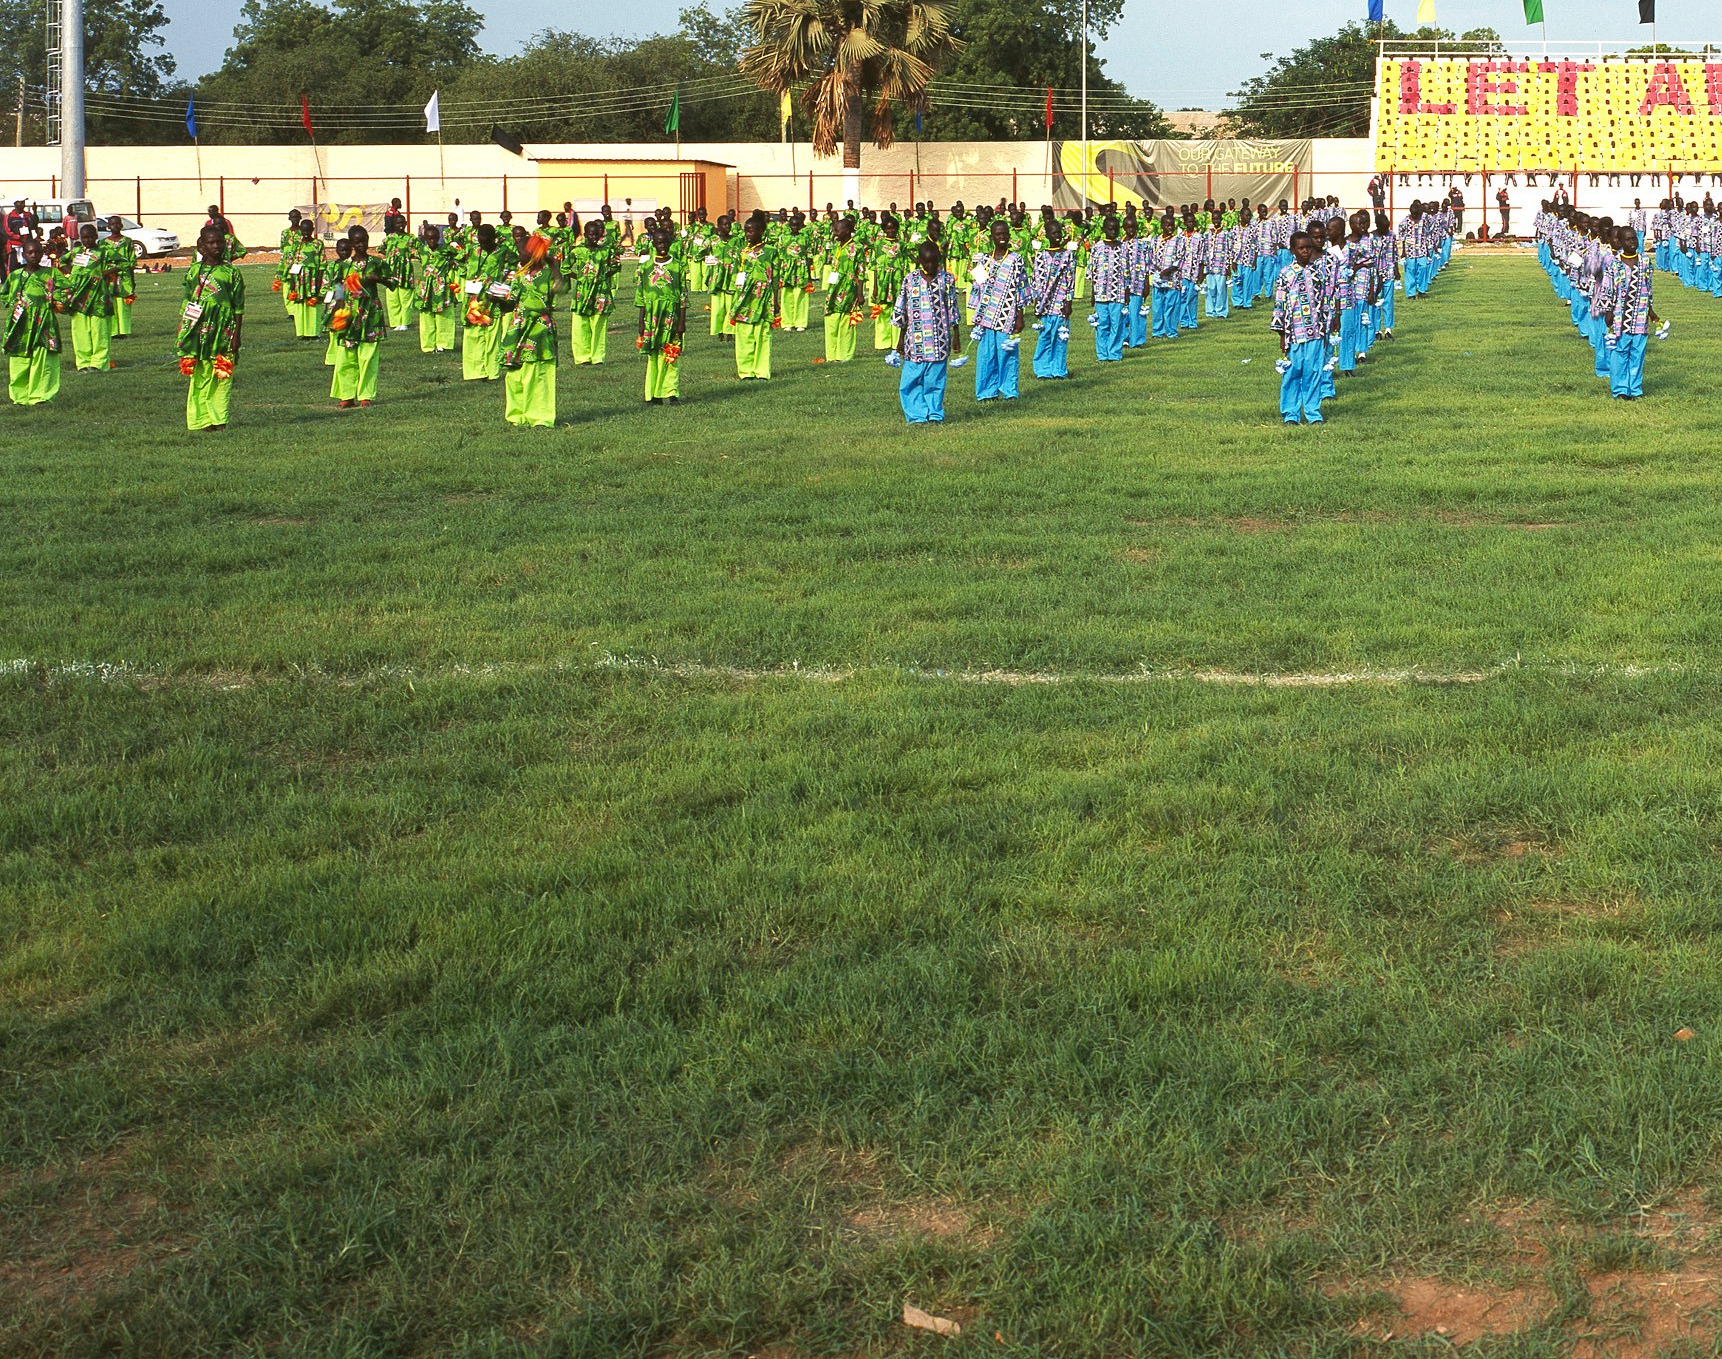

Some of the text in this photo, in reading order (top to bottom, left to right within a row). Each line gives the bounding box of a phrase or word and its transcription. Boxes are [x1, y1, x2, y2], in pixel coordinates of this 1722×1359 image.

[1398, 61, 1596, 116] LET
[1179, 146, 1281, 161] OUR GATEWAY
[1179, 161, 1294, 178] TO THE FUTURE
